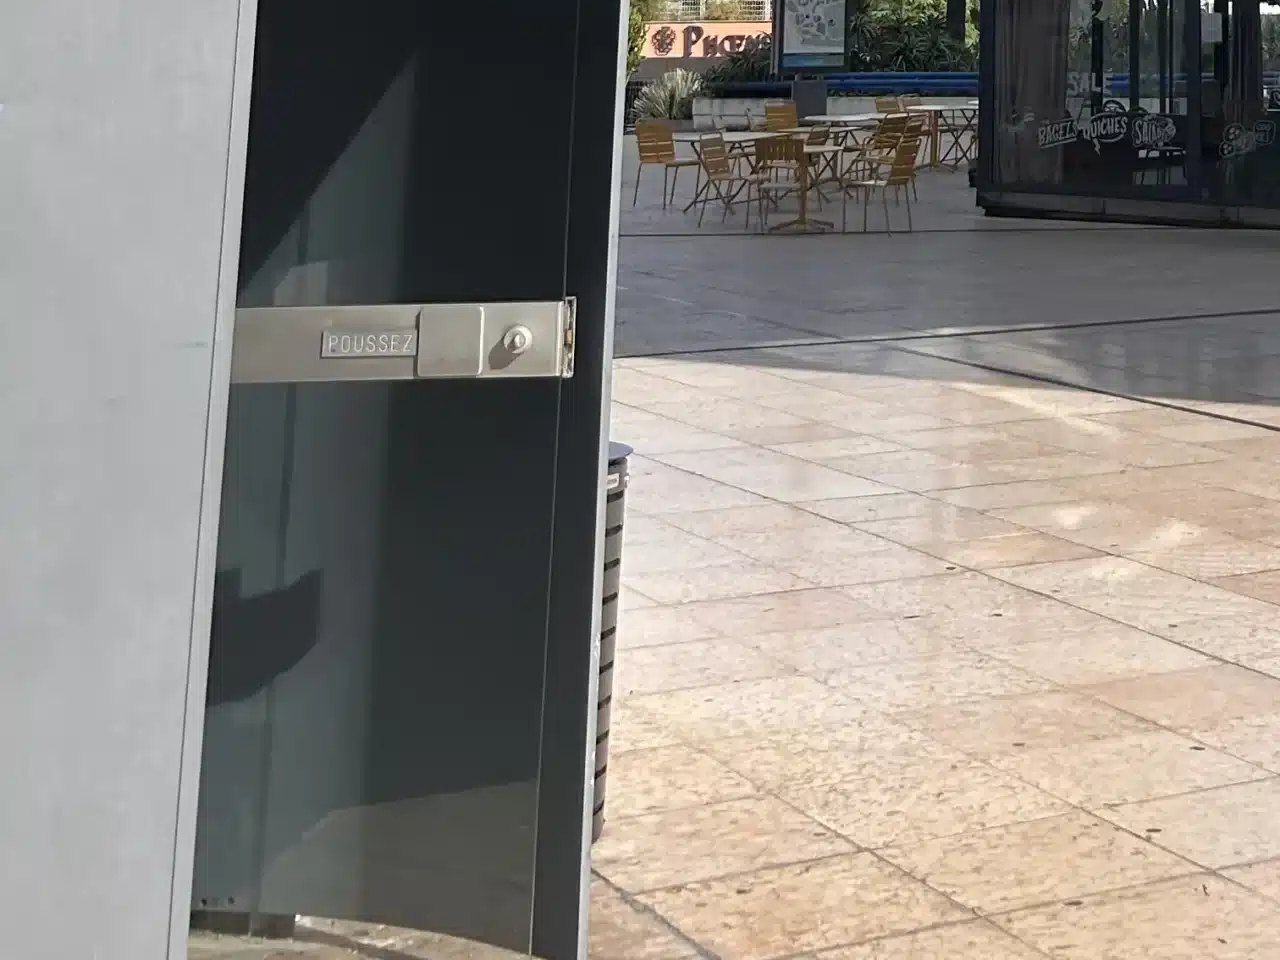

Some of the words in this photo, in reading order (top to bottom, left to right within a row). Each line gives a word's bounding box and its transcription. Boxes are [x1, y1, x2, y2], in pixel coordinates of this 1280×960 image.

[1038, 119, 1078, 147] BAGELS
[1083, 115, 1128, 141] QUICHES
[328, 334, 412, 353] POUSSEZ
